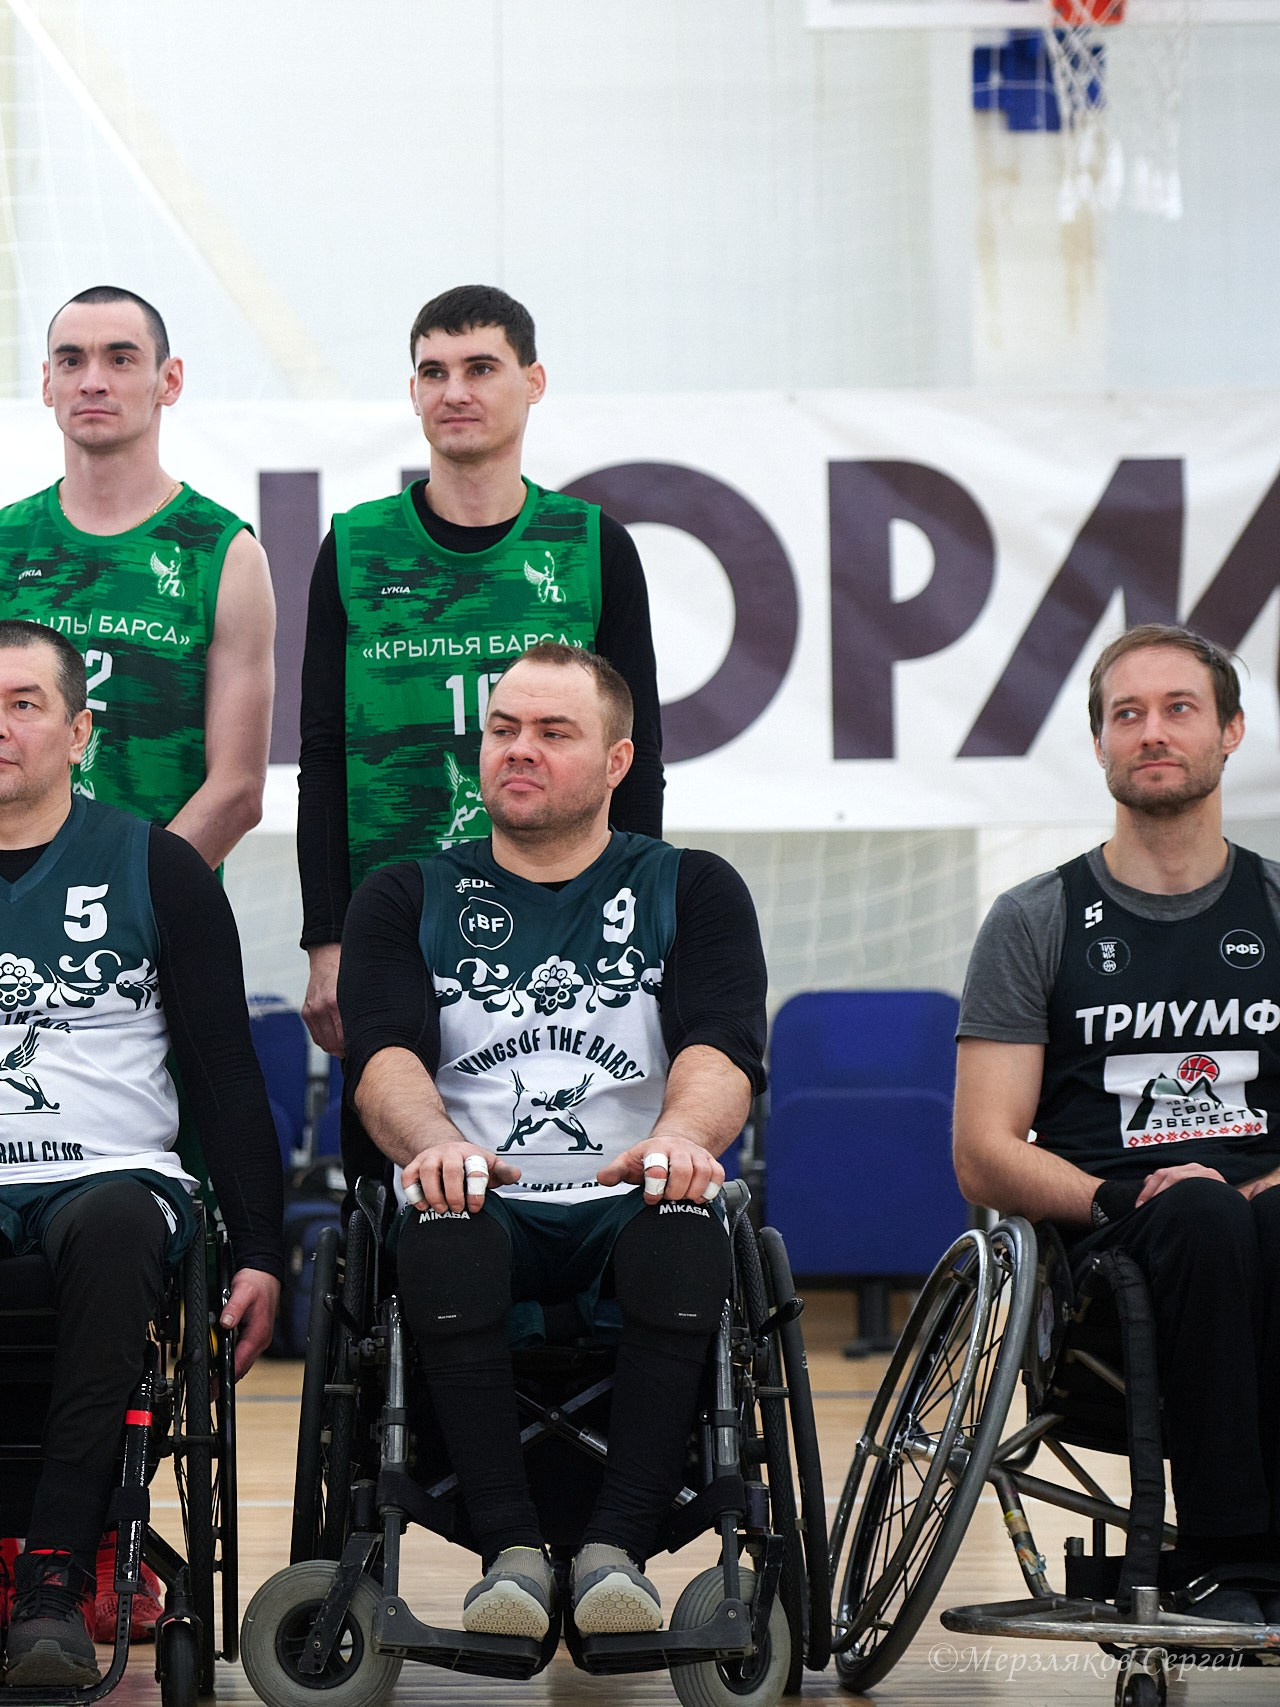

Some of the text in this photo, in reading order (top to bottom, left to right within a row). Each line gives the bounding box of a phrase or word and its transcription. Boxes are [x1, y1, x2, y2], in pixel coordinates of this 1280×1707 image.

[381, 586, 410, 595] LYKIA
[98, 615, 191, 645] БАРСА»
[362, 637, 481, 660] «КРЫЛЬЯ
[63, 883, 109, 942] 5
[602, 887, 637, 944] 9
[1226, 944, 1260, 955] РФБ
[1075, 998, 1280, 1046] ТРИУМФ
[453, 1037, 518, 1075] WINGS
[519, 1027, 541, 1055] OF
[546, 1025, 588, 1055] THE
[1152, 1109, 1246, 1129] ЭВЕРЕСТ
[41, 1140, 84, 1161] CLUB
